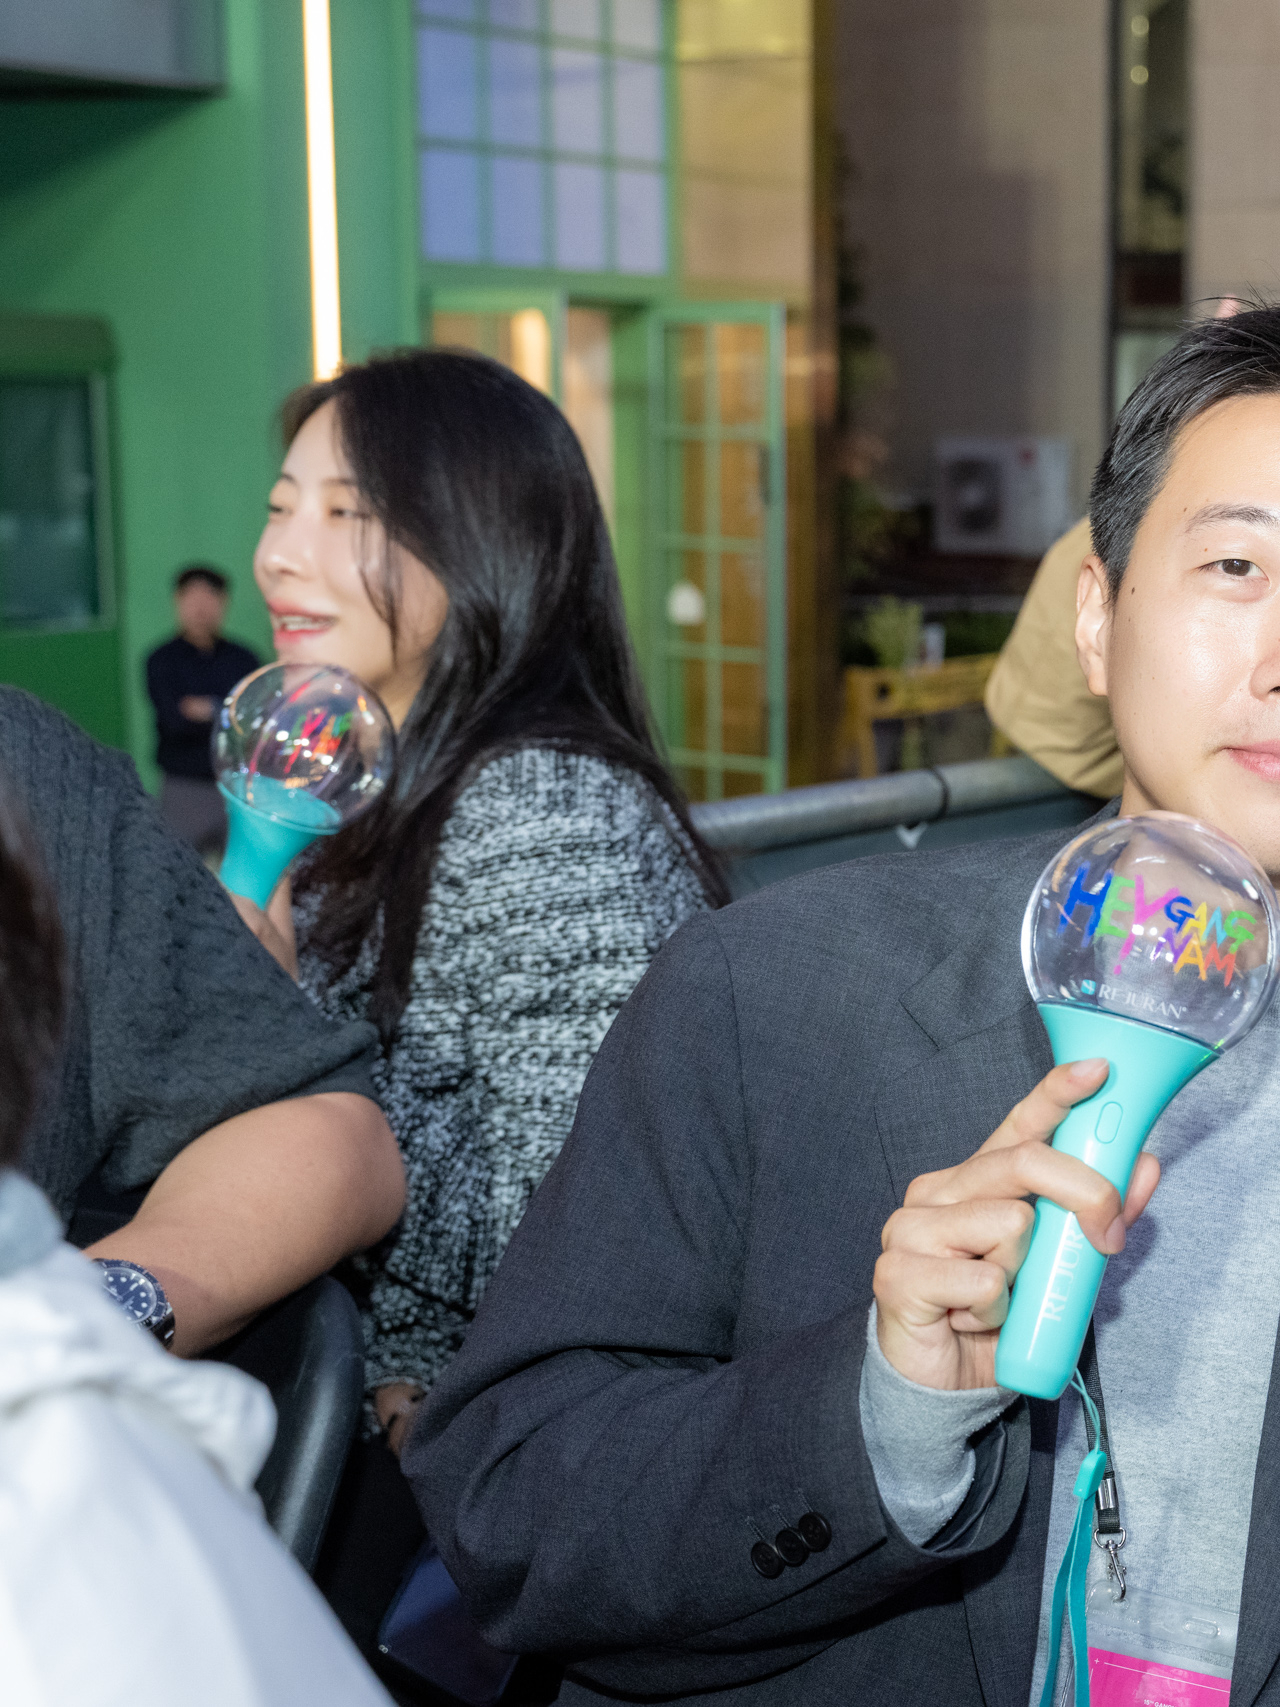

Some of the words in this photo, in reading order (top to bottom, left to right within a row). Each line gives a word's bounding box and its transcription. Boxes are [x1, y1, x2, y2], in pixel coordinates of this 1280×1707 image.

[1057, 859, 1180, 975] HEY
[1164, 895, 1257, 954] GANG
[1151, 927, 1236, 988] NAM
